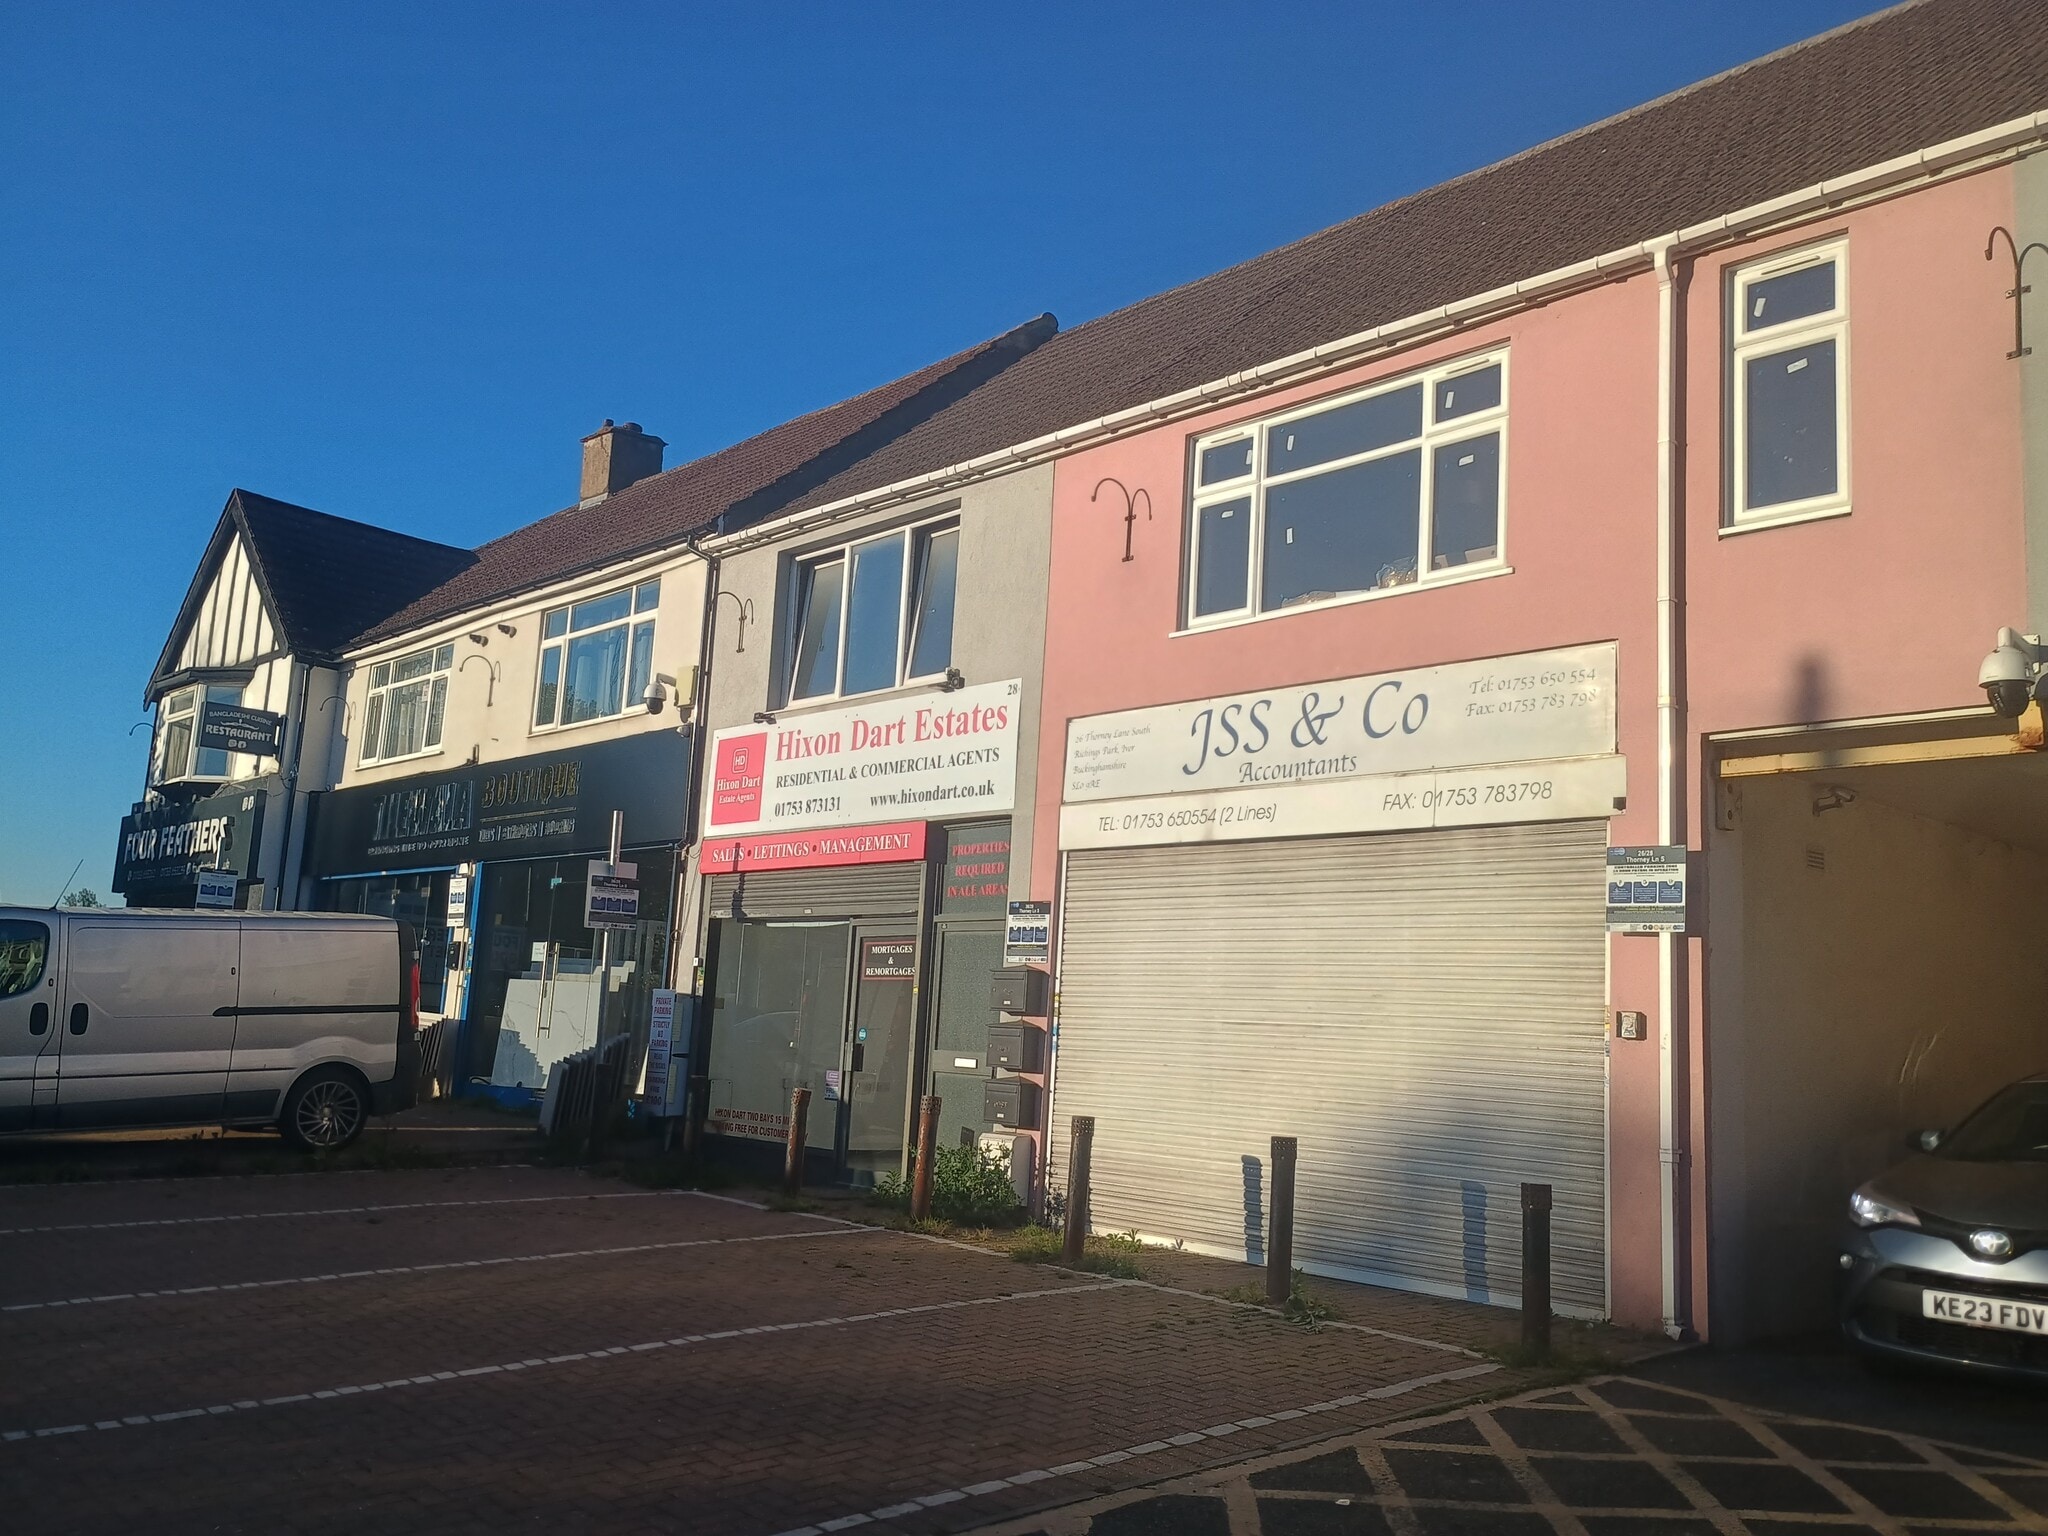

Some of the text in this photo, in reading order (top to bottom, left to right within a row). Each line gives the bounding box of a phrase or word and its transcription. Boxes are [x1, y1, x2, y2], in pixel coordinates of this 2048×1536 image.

[1470, 668, 1596, 694] Tel: 01753 650 554
[1007, 684, 1018, 696] 28
[1466, 689, 1596, 718] Fax: 01753 783 798
[206, 724, 272, 742] RESTAURANT
[775, 703, 1008, 762] Hixon Dart Estates
[1075, 723, 1150, 743] 26 Thorney Lane South
[1182, 680, 1429, 775] JSS & Co
[735, 755, 746, 766] HD
[1074, 746, 1100, 760] Richings
[776, 747, 1000, 788] RESIDENTIAL & COMMERCIAL AGENTS
[1073, 760, 1127, 776] Buckinghamshire
[1239, 754, 1357, 783] Accountants
[716, 776, 760, 792] Hixon Dart
[719, 792, 755, 804] Estate Agents
[774, 779, 995, 817] 01753 873131 www.hixondart.co.uk
[1382, 781, 1552, 811] FAX: 01753 783798
[1099, 804, 1277, 832] TEL: 01753 650554 (2 Lines)
[123, 829, 158, 866] FOUR
[712, 834, 911, 863] SALES LETTINGS MANAGEMENT
[952, 841, 1010, 856] PROPERTIES
[955, 862, 1005, 877] REQUIRED
[947, 886, 957, 898] IN
[872, 945, 912, 954] MORTGAGES
[888, 956, 894, 964] &
[866, 966, 916, 976] REMORTGAGES
[714, 1108, 731, 1118] HIXON
[732, 1110, 746, 1120] DART
[747, 1112, 758, 1121] TWO
[760, 1113, 774, 1124] BAYS
[775, 1115, 782, 1124] 15
[734, 1123, 747, 1134] FREE
[748, 1125, 758, 1134] FOR
[759, 1126, 789, 1139] CUSTOMER
[1933, 1295, 2046, 1330] KE23 FDV
